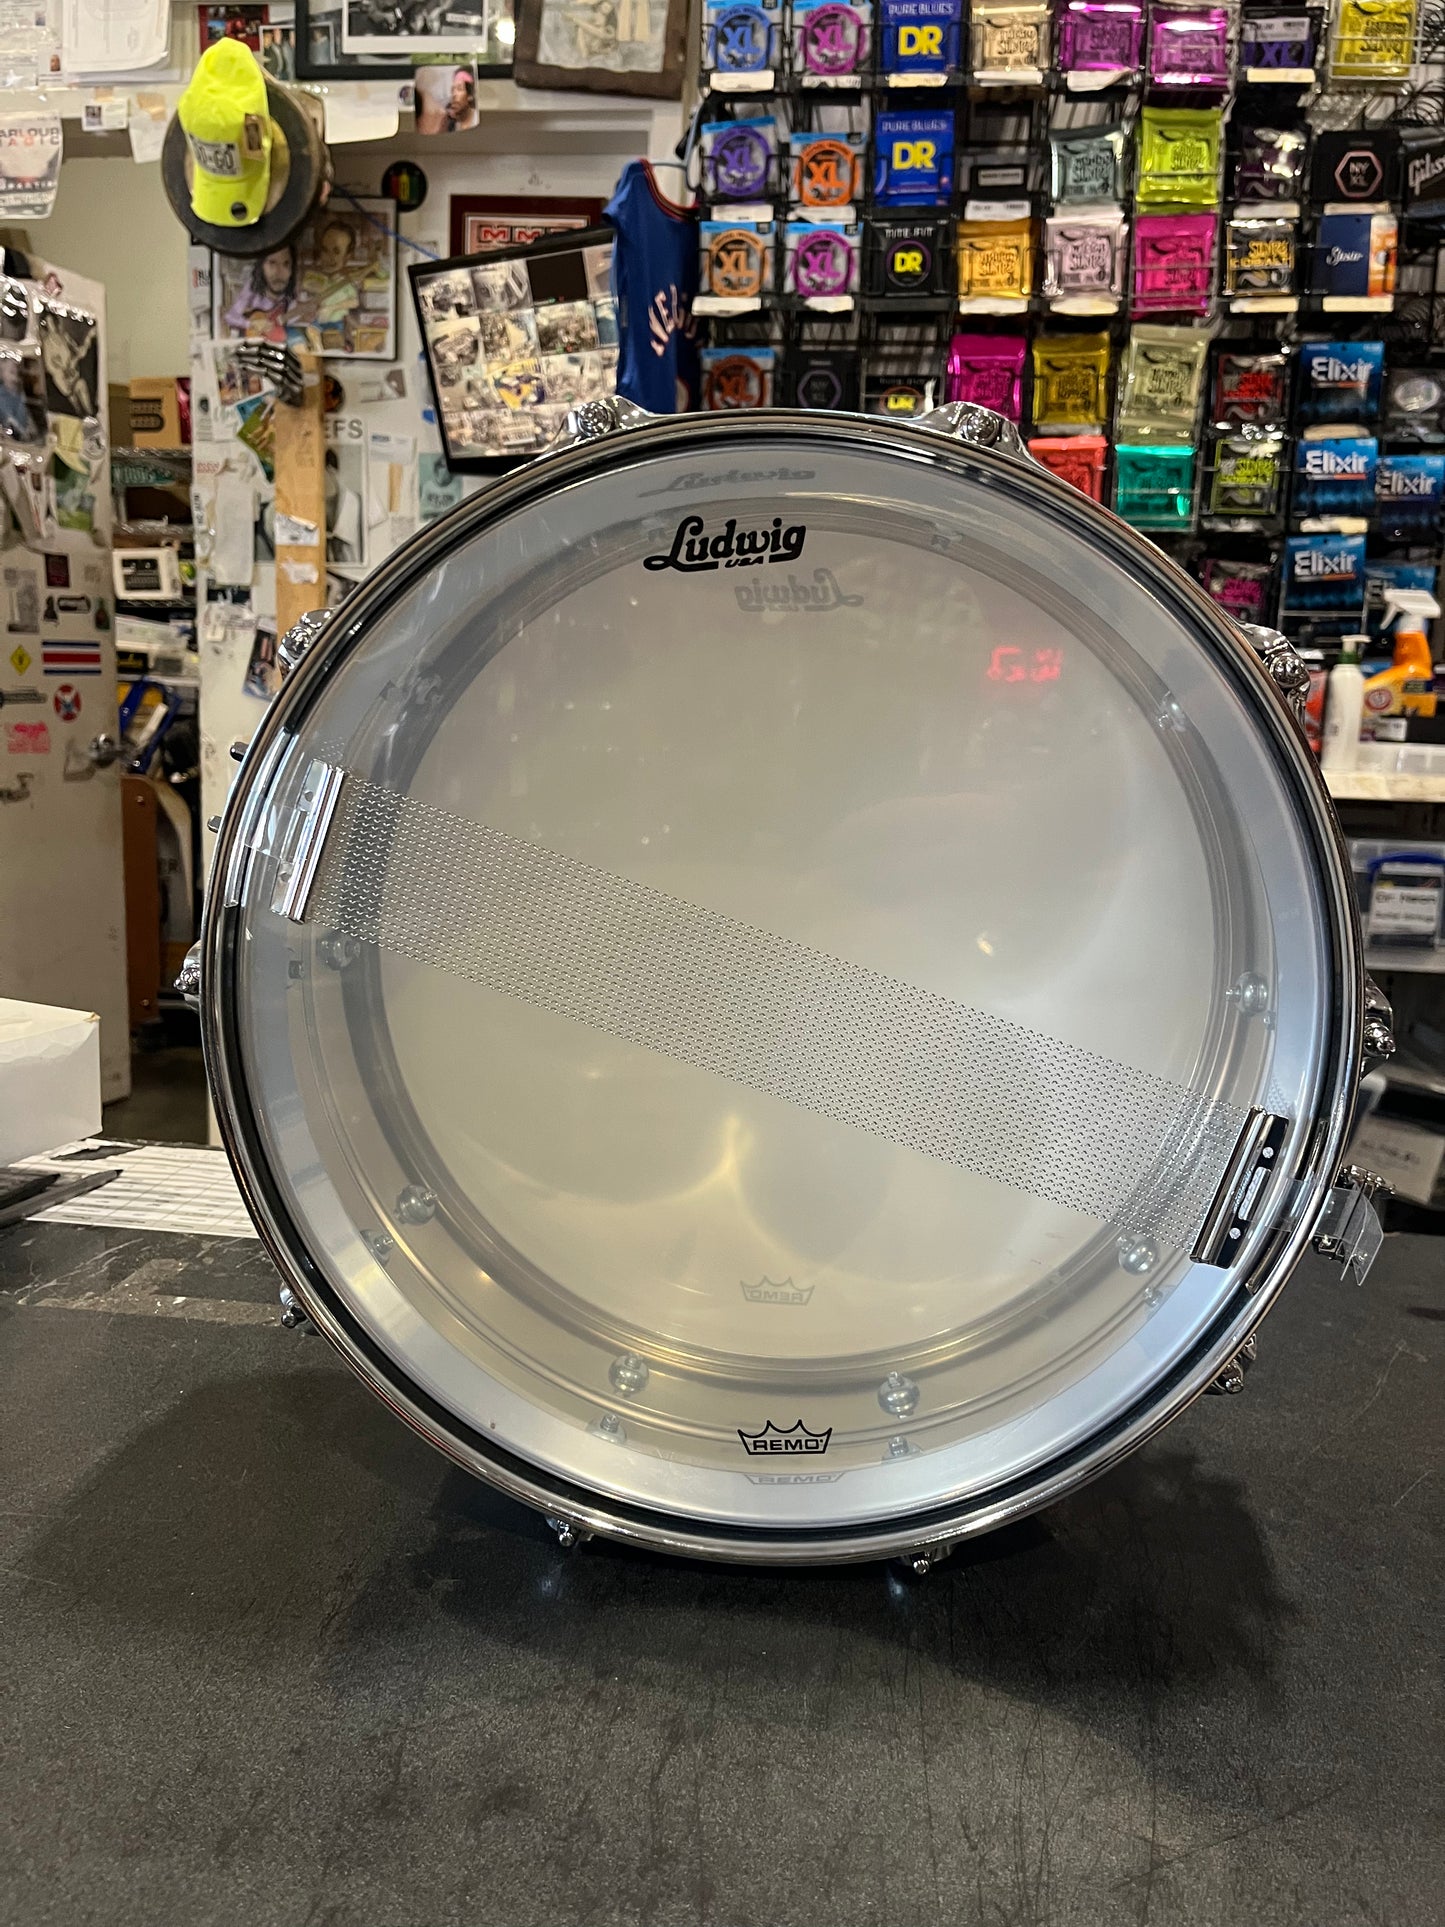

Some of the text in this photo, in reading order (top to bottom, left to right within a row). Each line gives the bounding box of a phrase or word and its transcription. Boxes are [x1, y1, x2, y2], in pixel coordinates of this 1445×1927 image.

[888, 3, 954, 15] PURE BLUES
[724, 26, 759, 54] XL
[815, 25, 851, 52] XL
[898, 25, 943, 56] DR
[882, 119, 948, 131] PURE BLUES
[722, 149, 760, 177] XL
[892, 140, 936, 170] DR
[808, 161, 846, 189] XL
[718, 250, 758, 276] XL
[804, 251, 841, 280] XL
[893, 251, 922, 274] DR
[1310, 356, 1375, 382] Elixir
[1305, 449, 1369, 474] Elixir
[1374, 469, 1438, 496] Elixir
[643, 515, 807, 573] Ludwig
[724, 555, 764, 568] USA
[1293, 550, 1358, 576] Elixir
[752, 1438, 821, 1451] REMO
